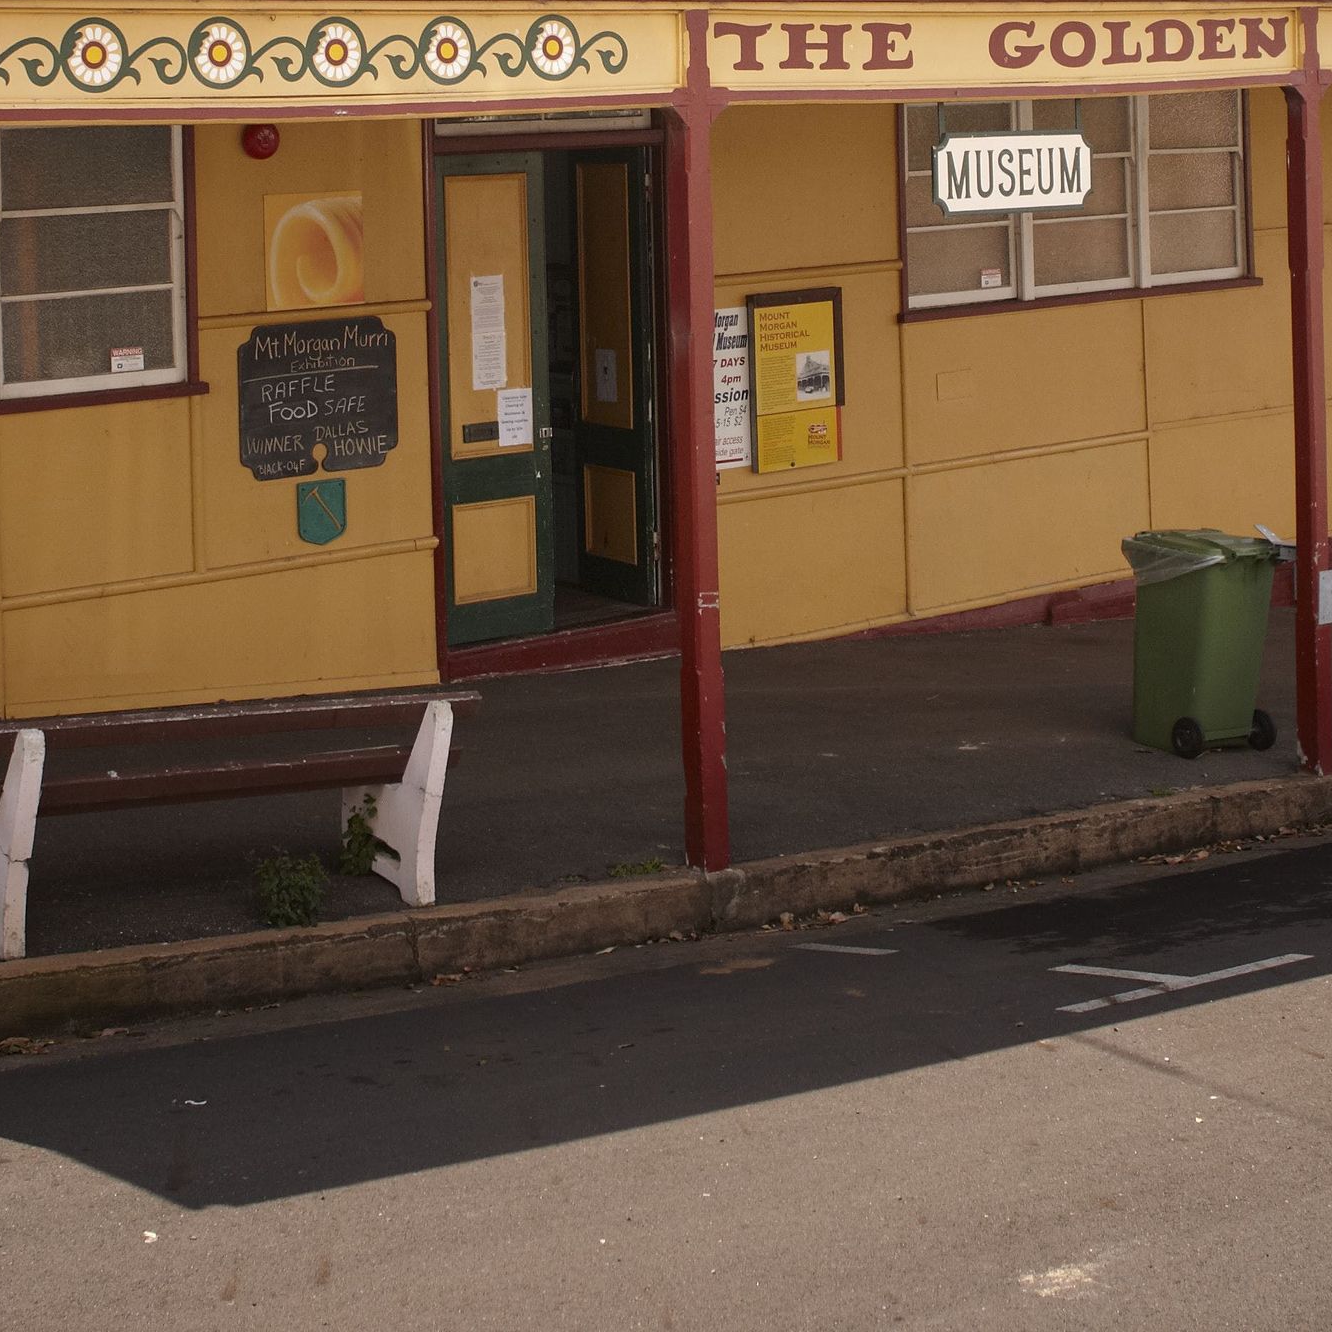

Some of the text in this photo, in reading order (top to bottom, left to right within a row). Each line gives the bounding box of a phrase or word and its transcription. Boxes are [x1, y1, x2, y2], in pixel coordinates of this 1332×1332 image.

[714, 22, 913, 71] THE
[987, 16, 1290, 69] GOLDEN
[946, 146, 1083, 200] MUSEUM
[254, 324, 388, 361] Mt. Morgan Murri
[716, 332, 749, 351] Museum
[290, 356, 356, 373] Exhibition
[720, 356, 746, 368] DAYS
[261, 374, 336, 403] RAFFLE
[721, 374, 742, 385] 4pm
[324, 395, 366, 416] SAFE
[313, 420, 369, 442] DALLAS
[247, 434, 389, 457] WINNER HOWIE
